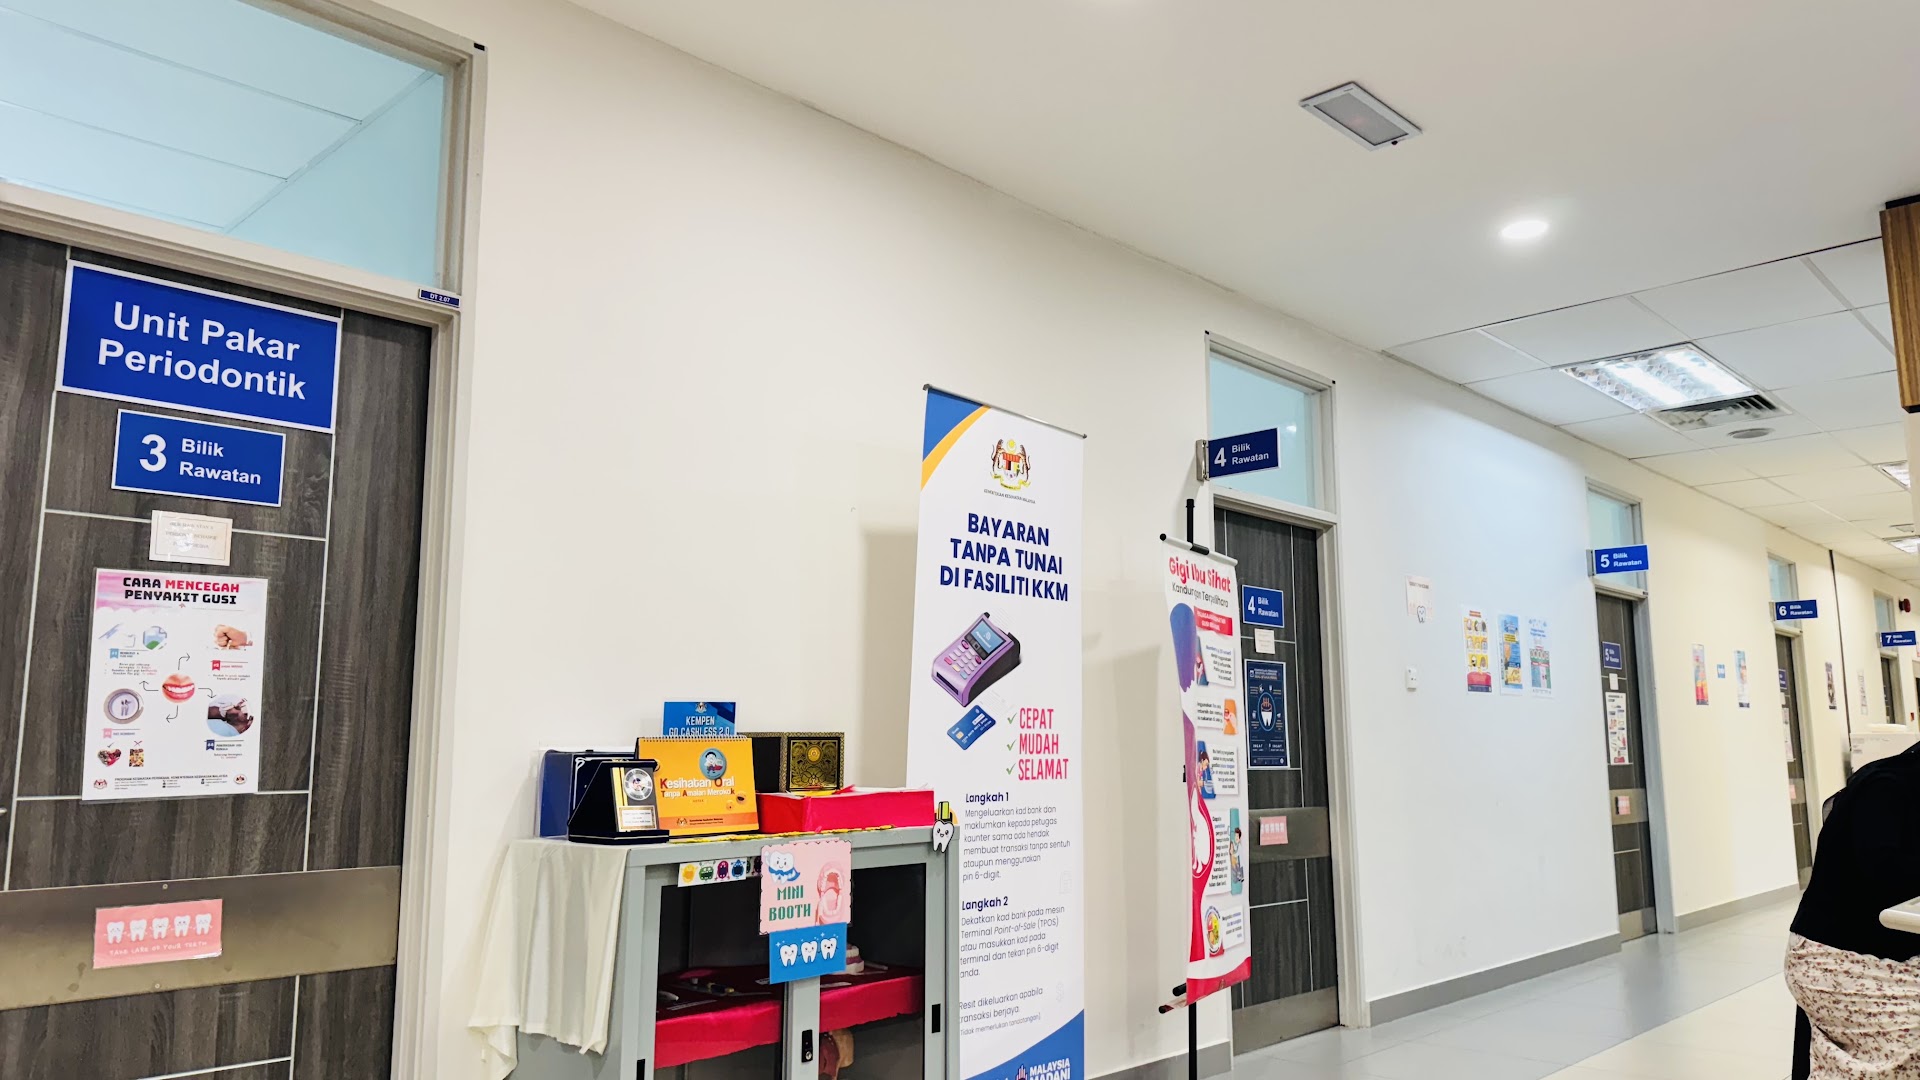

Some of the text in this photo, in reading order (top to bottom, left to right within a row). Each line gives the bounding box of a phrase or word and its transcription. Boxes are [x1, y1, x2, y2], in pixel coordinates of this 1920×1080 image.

[114, 301, 300, 361] Unit Pakar
[98, 338, 306, 400] Periodontik
[139, 434, 224, 472] 3 Bilik
[1214, 443, 1251, 467] 4 Bilik
[1232, 452, 1269, 465] Rawatan
[179, 461, 261, 484] Rawatan
[968, 512, 1049, 547] BAYARAN
[950, 538, 1062, 574] TANPA TUNAI
[1600, 554, 1610, 568] 5
[1613, 559, 1642, 567] Rawatan
[1169, 556, 1231, 593] Gigi Ibu Sihat
[123, 577, 239, 592] CARA MENCEGAH
[940, 565, 1068, 601] DI FASILITI KKM
[125, 590, 236, 604] PENYAKIT GUSI
[1248, 596, 1269, 614] 4 Bilik
[1258, 607, 1279, 618] Rawatan
[1779, 606, 1787, 616] 6
[1885, 635, 1892, 643] 7
[1605, 648, 1609, 661] 5
[686, 716, 715, 725] KEMPEN
[1020, 707, 1054, 729] CEPAT
[669, 727, 730, 736] GO CASHLESS 2.0
[1020, 733, 1059, 754] MUDAH
[1018, 759, 1069, 780] SELAMAT
[660, 776, 735, 789] Kesihatan Oral
[966, 792, 1009, 805] Langkah 1
[965, 808, 1014, 819] Mengeluarkan
[1016, 807, 1026, 815] kad
[1028, 806, 1041, 814] bank
[965, 818, 1057, 830] maklumkan kepada petugas
[964, 834, 990, 842] kaunter
[1014, 831, 1025, 840] ada
[1027, 829, 1049, 838] hendak
[964, 840, 1070, 855] membuat transaksi tanpa sentuh
[963, 854, 1041, 869] ataupun menggunakan
[963, 871, 1001, 883] pin 6-digit.
[777, 885, 803, 900] MINI
[962, 896, 1008, 912] Langkah 2
[769, 904, 811, 921] BOOTH
[961, 906, 1064, 926] Dekatkan kad bank pada mesin
[961, 916, 1058, 939] Terminal Point-of-Sale (TPOS)
[961, 943, 977, 952] atau
[978, 937, 1015, 950] masukkan
[1029, 932, 1046, 942] pada
[960, 942, 1059, 965] terminal dan tekan pin 6-digit
[960, 968, 980, 978] anda.
[960, 987, 1043, 1010] Resit dikeluarkan apabila
[960, 1011, 991, 1023] ransaksi
[1030, 1058, 1070, 1076] MALAYSIA
